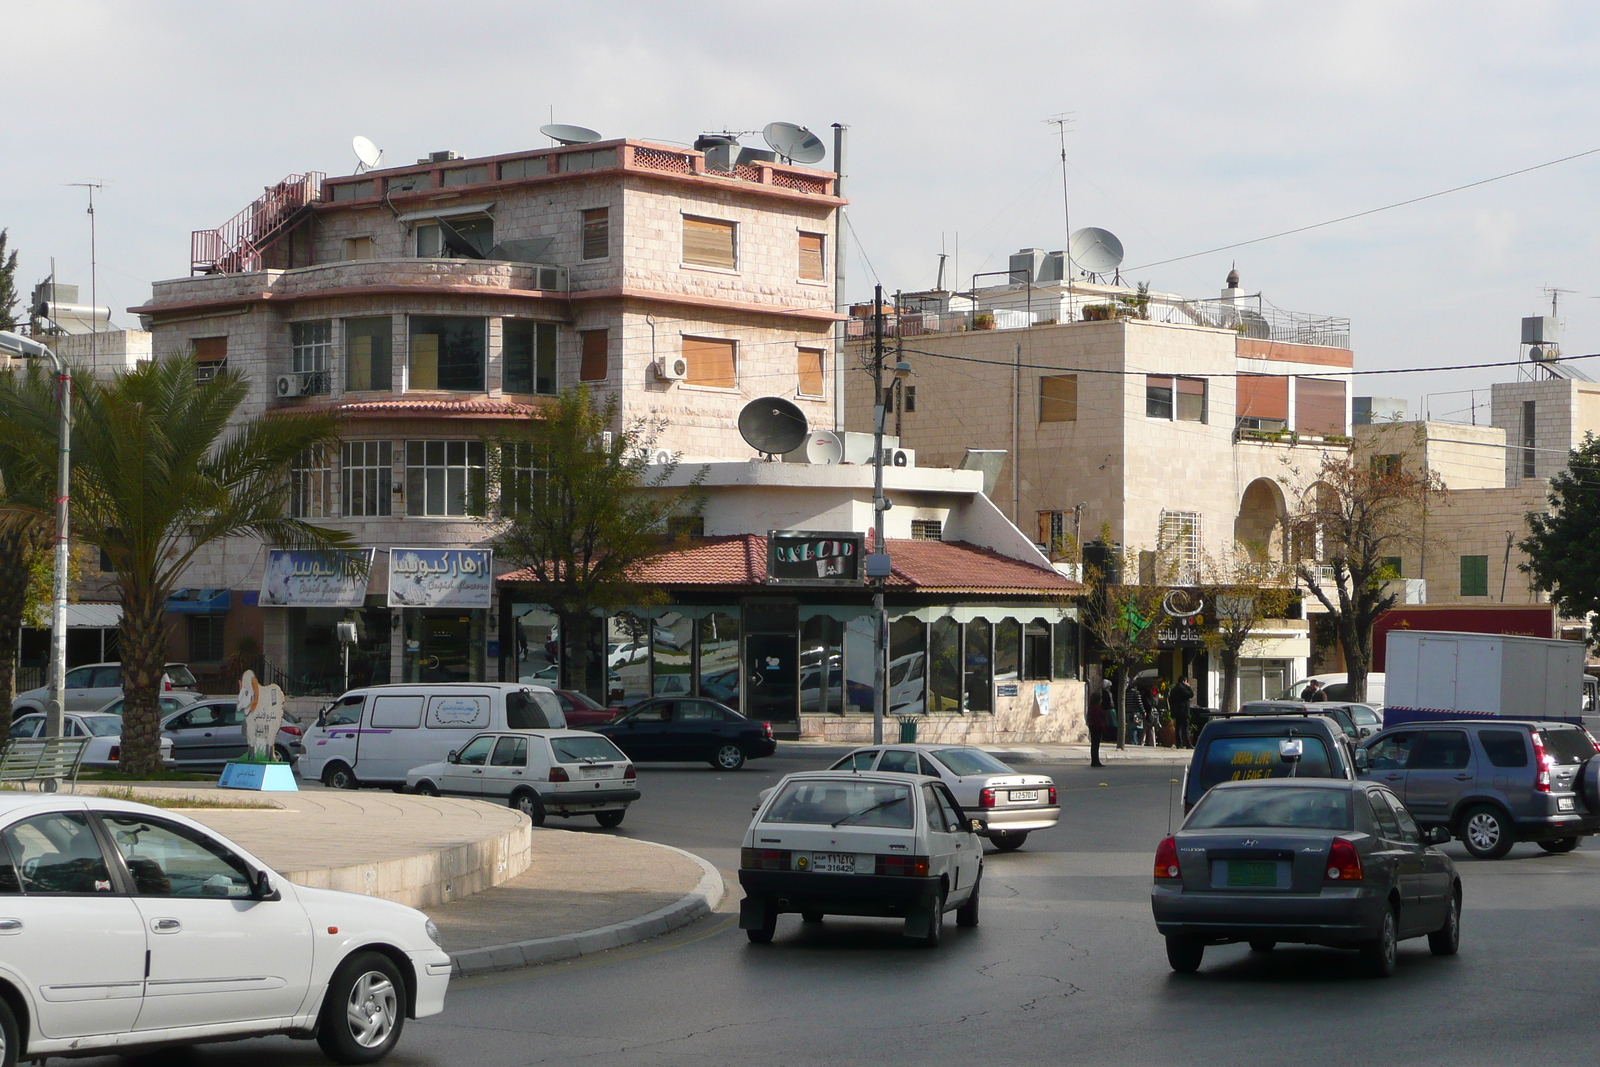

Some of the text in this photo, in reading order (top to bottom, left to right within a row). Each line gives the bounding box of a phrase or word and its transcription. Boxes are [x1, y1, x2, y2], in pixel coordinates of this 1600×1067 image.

[776, 540, 854, 563] CALCIO
[1231, 750, 1254, 765] JORDAN
[1254, 750, 1273, 765] LOVE
[1231, 768, 1273, 781] OR LEAVE IT
[827, 864, 854, 872] 316425
